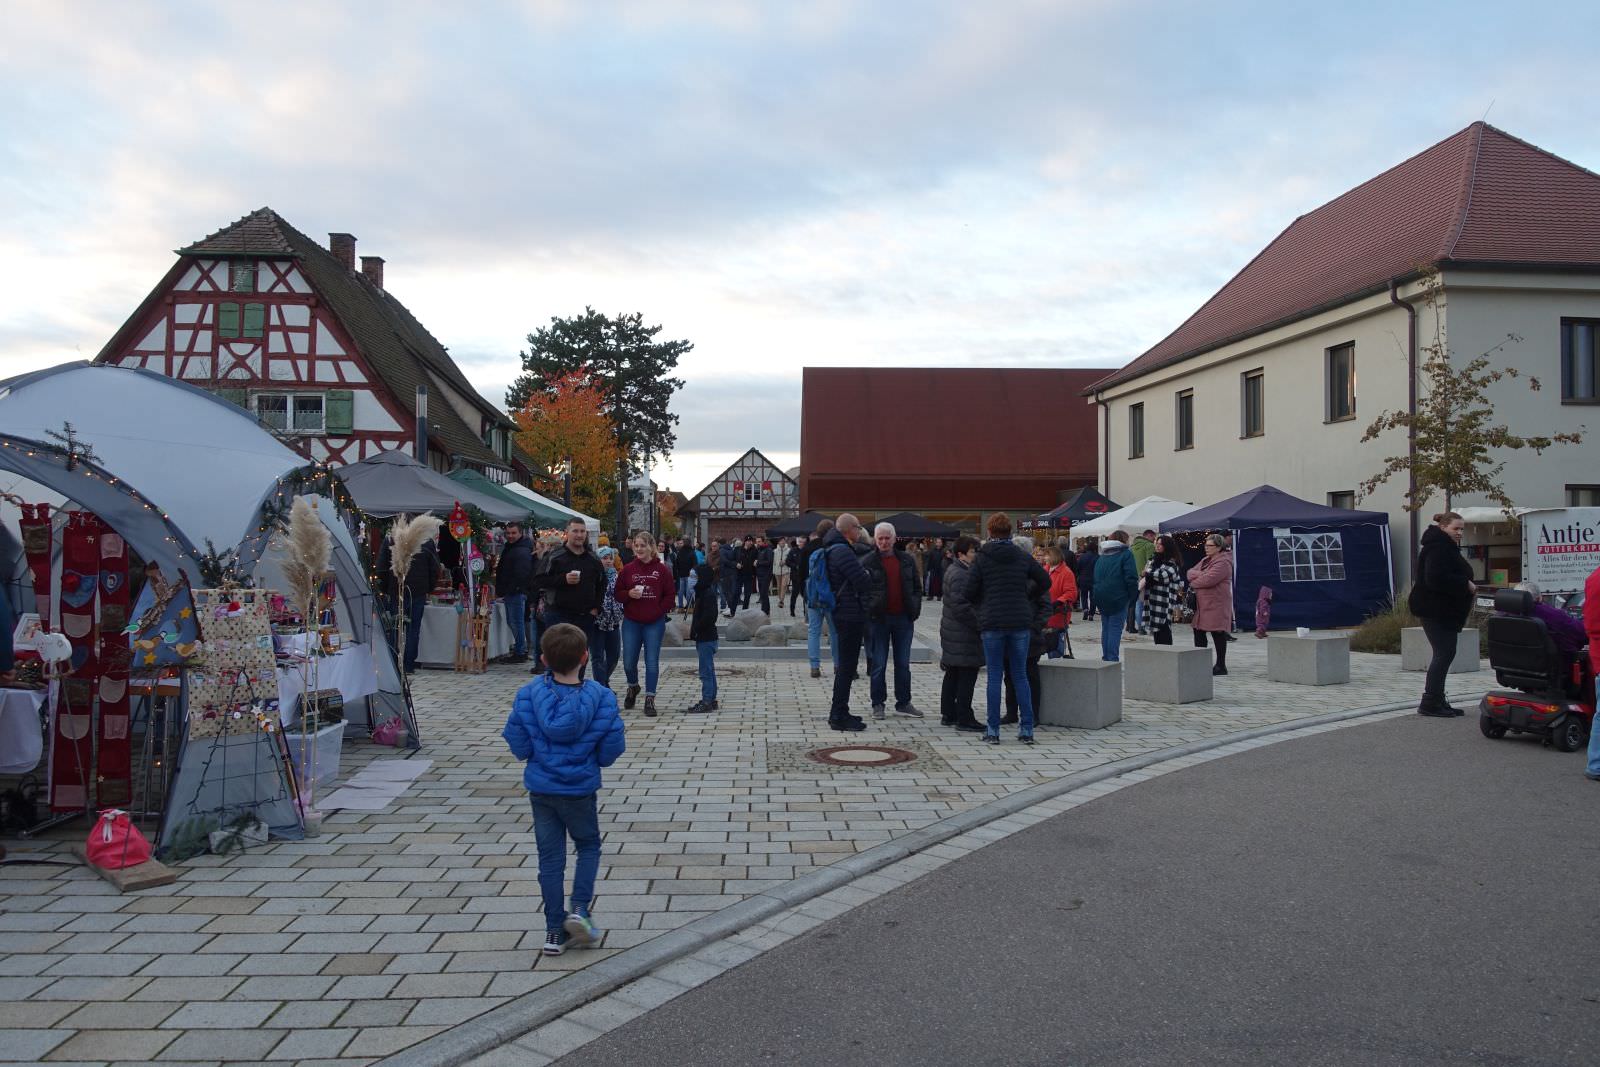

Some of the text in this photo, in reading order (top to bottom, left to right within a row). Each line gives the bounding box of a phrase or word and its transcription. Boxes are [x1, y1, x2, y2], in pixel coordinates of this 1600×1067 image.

[1538, 522, 1594, 545] Antje
[1538, 544, 1600, 553] FUTTERKRIP
[1541, 554, 1560, 562] Alles
[1561, 554, 1572, 562] für
[1573, 553, 1587, 561] den
